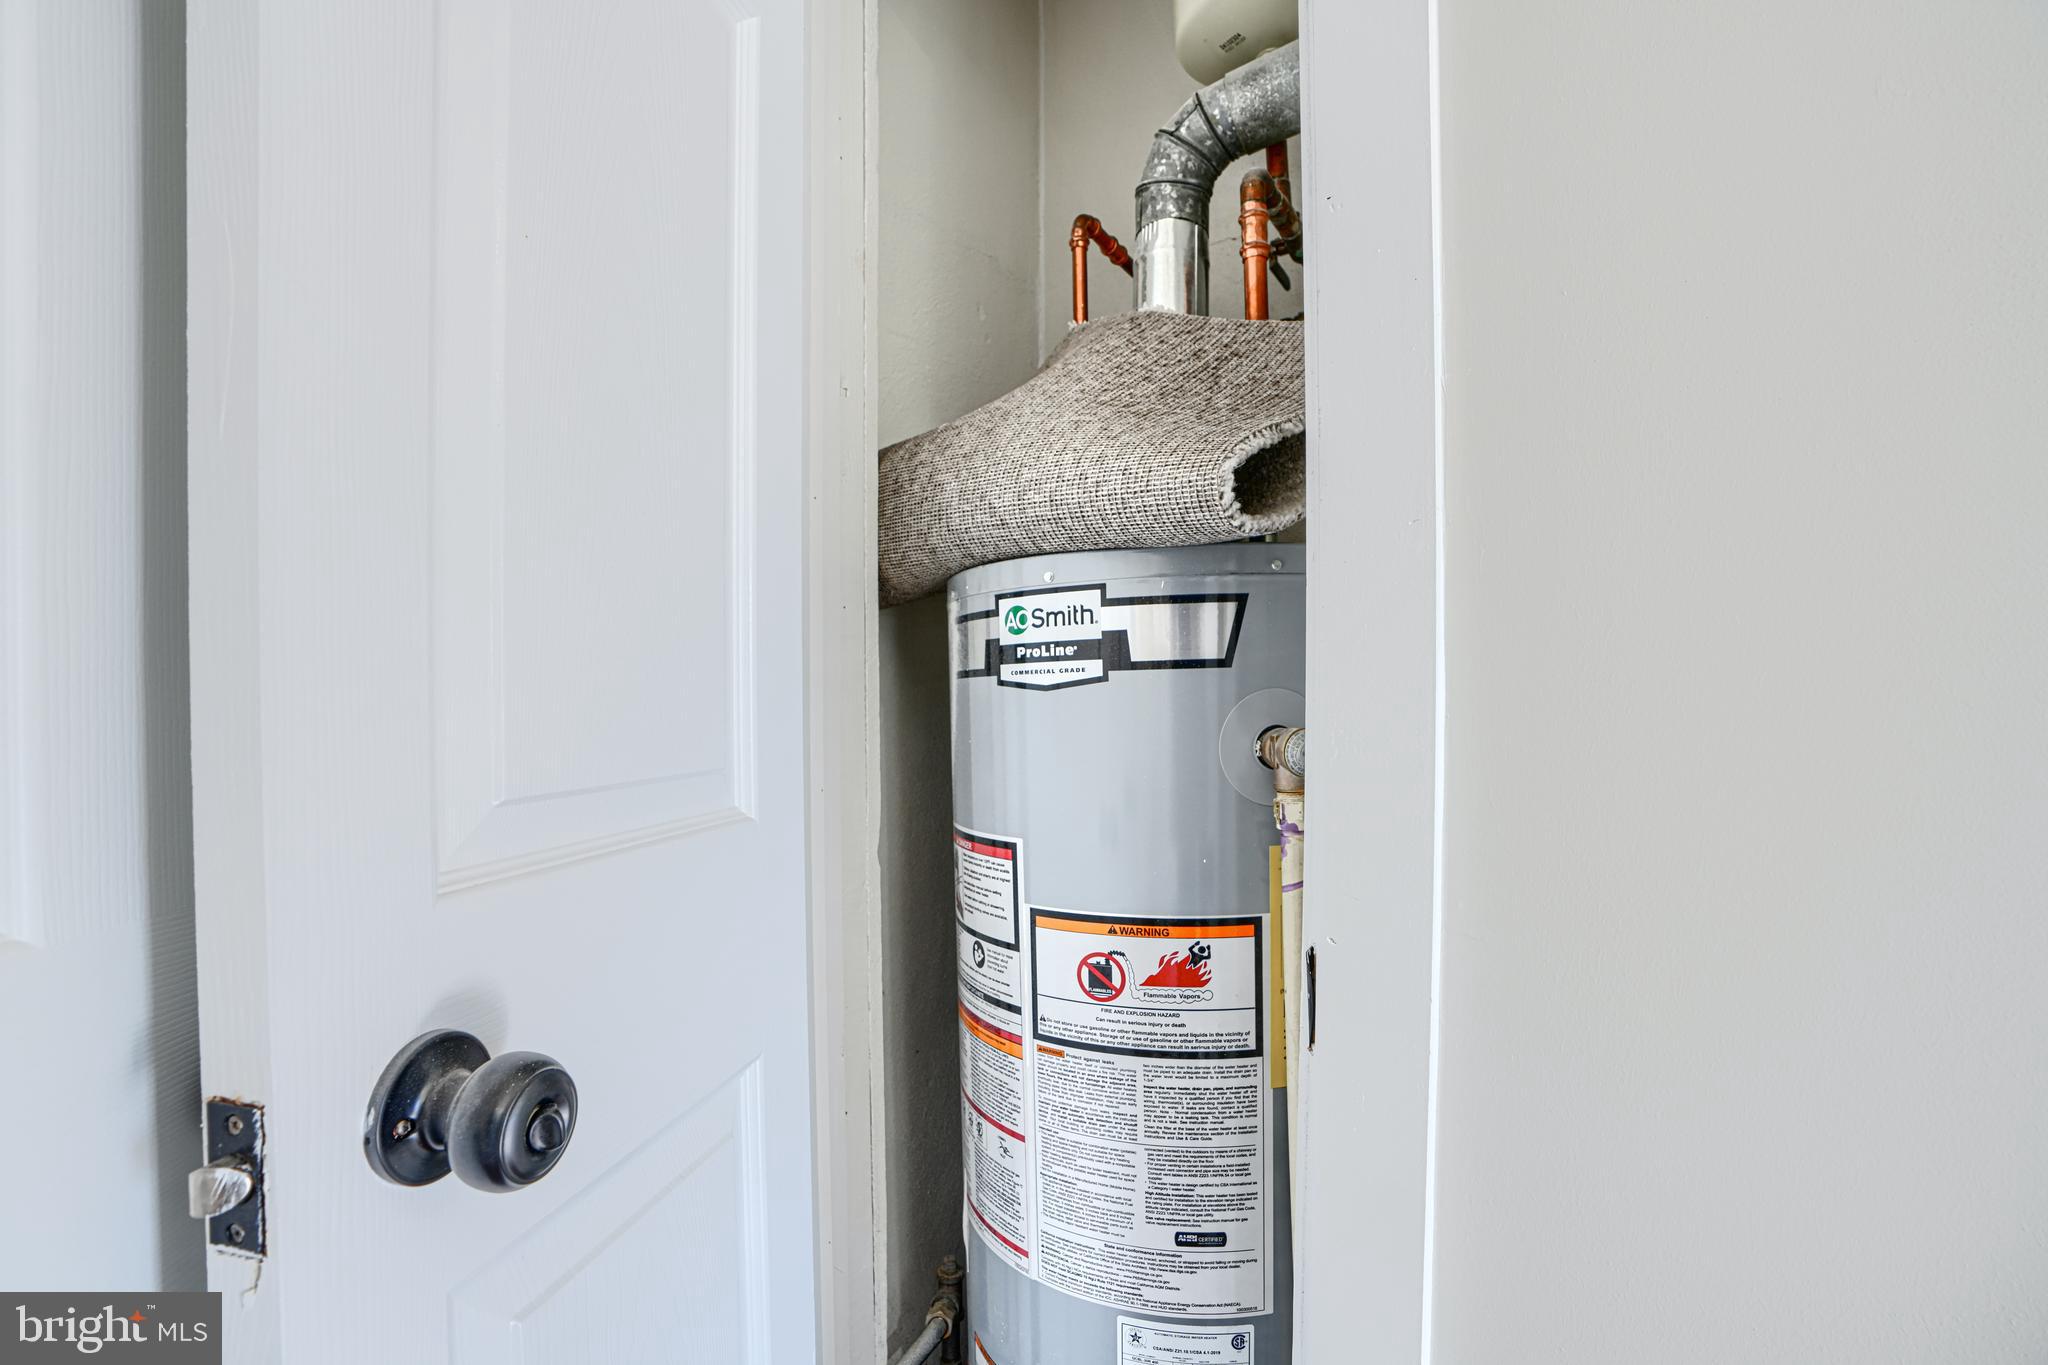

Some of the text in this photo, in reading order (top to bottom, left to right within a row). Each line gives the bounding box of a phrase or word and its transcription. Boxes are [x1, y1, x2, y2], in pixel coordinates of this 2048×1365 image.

[1032, 604, 1094, 628] Smith
[1016, 644, 1074, 658] ProLine
[1120, 926, 1170, 936] WARNING
